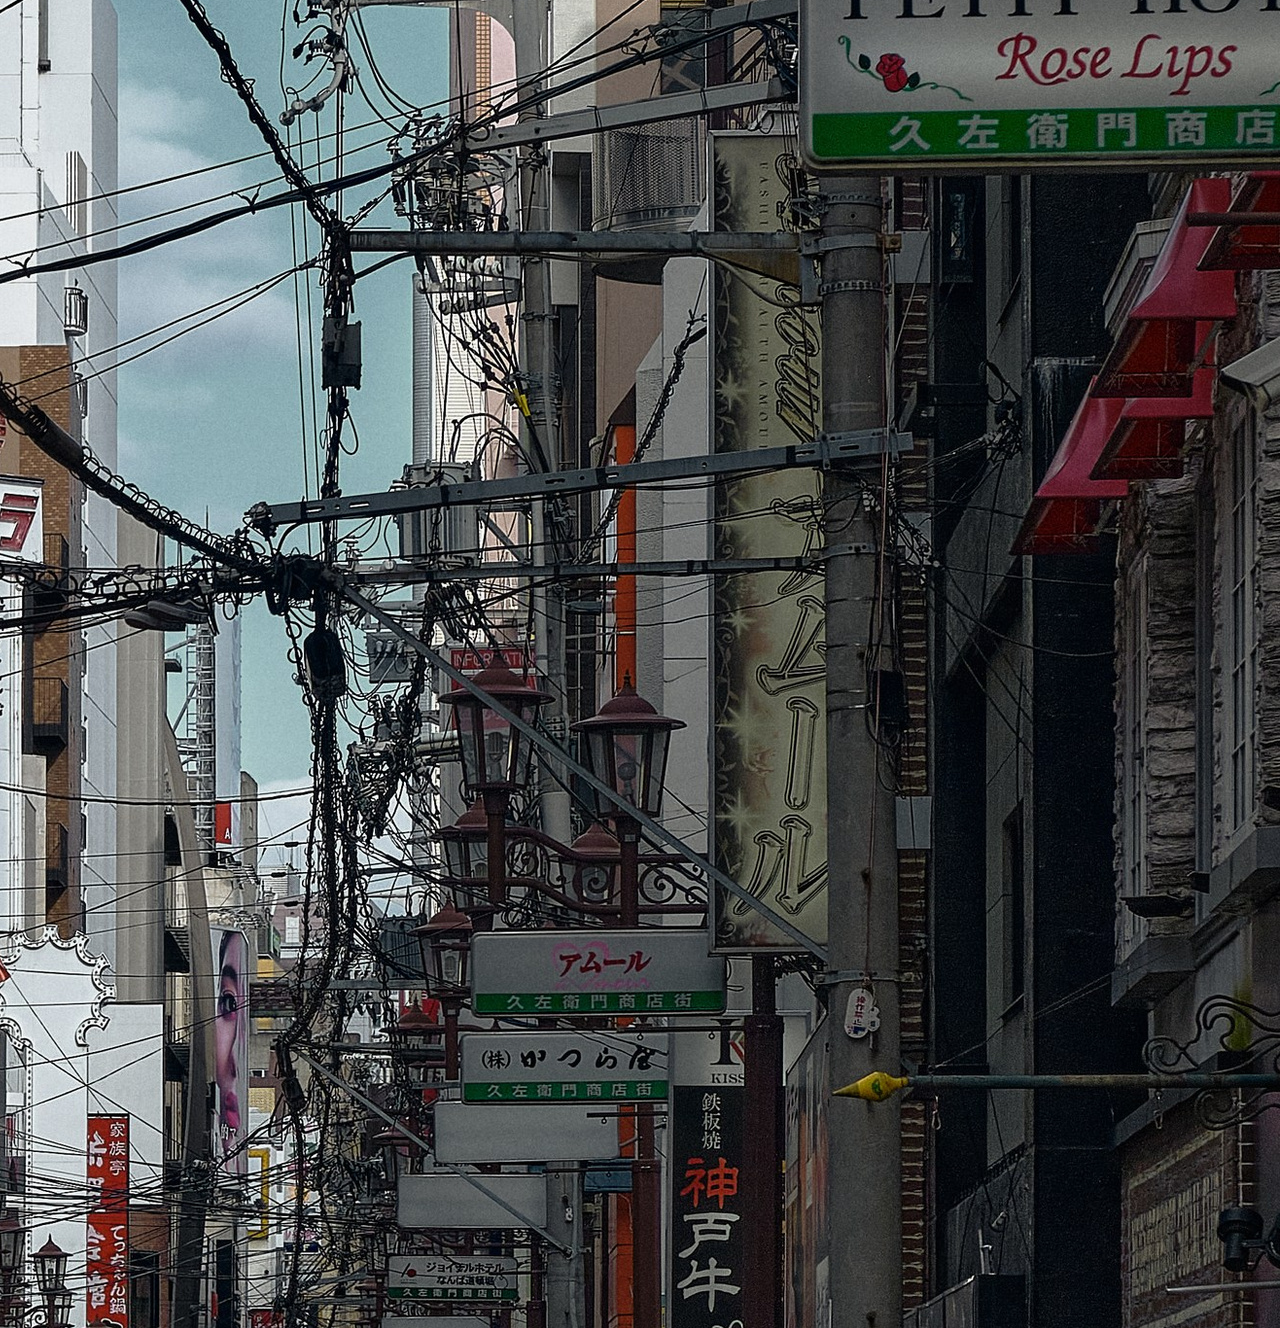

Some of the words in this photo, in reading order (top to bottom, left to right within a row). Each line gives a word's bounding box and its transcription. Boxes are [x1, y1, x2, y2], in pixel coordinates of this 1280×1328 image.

[996, 31, 1113, 88] Rose
[1122, 34, 1238, 97] Lips
[889, 110, 1276, 153] 久左衛門商店
[558, 950, 653, 978] アムール
[506, 993, 693, 1010] 久左衛門商店街
[486, 1082, 653, 1097] 久左衛門商店街
[701, 1092, 723, 1150] 鉄板焼
[109, 1120, 126, 1176] 家族亭
[676, 1155, 742, 1314] 神戸牛
[402, 1288, 503, 1298] 久左衛門商店街
